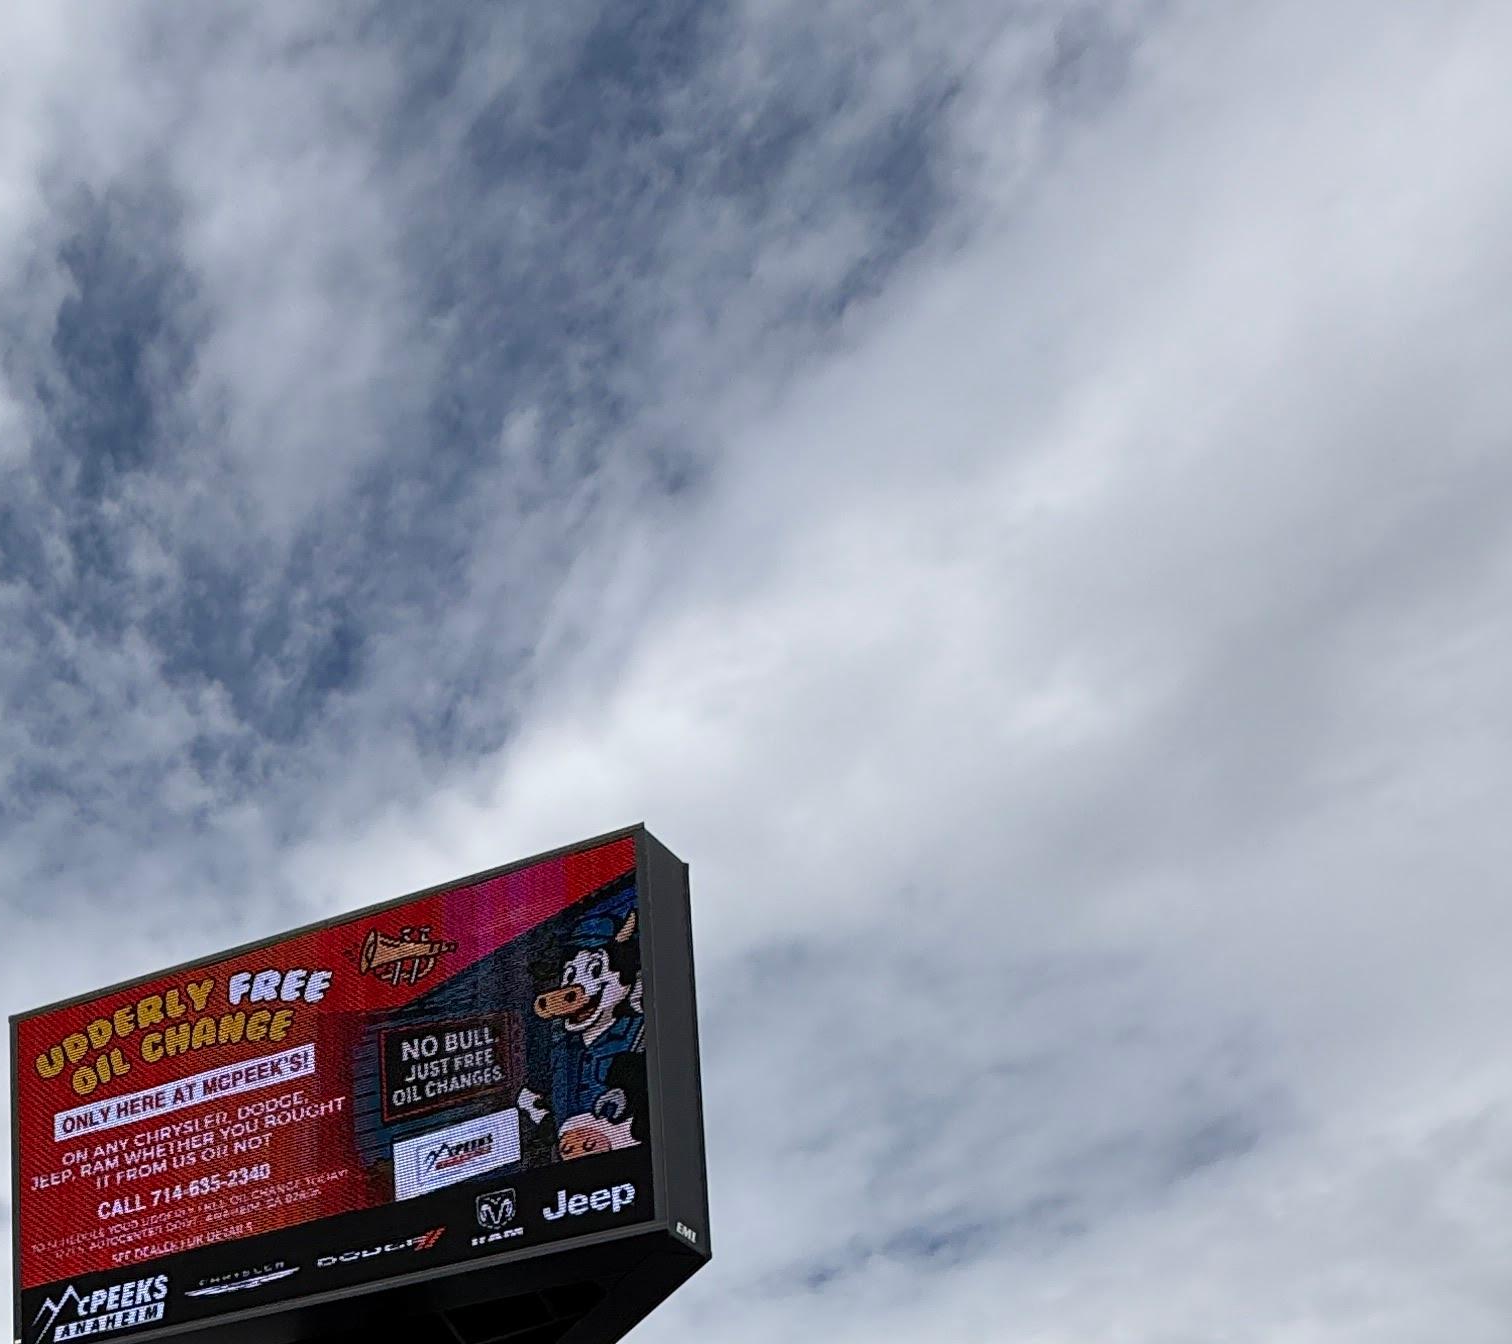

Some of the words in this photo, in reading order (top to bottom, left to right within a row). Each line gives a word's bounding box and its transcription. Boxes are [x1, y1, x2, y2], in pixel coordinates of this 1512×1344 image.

[36, 979, 215, 1078] UDDERLY
[227, 968, 333, 1006] FREE
[72, 1047, 131, 1095] OIL
[141, 1009, 294, 1063] CHANGE
[401, 1035, 438, 1062] NO
[405, 1058, 450, 1082] JUST
[454, 1048, 494, 1071] FREE
[63, 1106, 110, 1134] ONLY
[116, 1091, 166, 1119] HERE
[172, 1082, 196, 1105] AT
[202, 1050, 311, 1099] MCPEEK'S!
[393, 1085, 422, 1107] OIL
[62, 1148, 88, 1166] ON
[94, 1138, 129, 1157] ANY
[80, 1156, 119, 1177] RAM
[124, 1132, 214, 1164] WHETHER
[220, 1118, 258, 1140] YOU
[96, 1175, 109, 1190] IT
[116, 1159, 167, 1186] FROM
[173, 1152, 196, 1169] US
[201, 1144, 228, 1162] OR
[234, 1132, 273, 1154] NOT
[97, 1194, 147, 1219] CALL
[542, 1182, 636, 1222] Jeep
[58, 1302, 164, 1340] ANAHEIM
